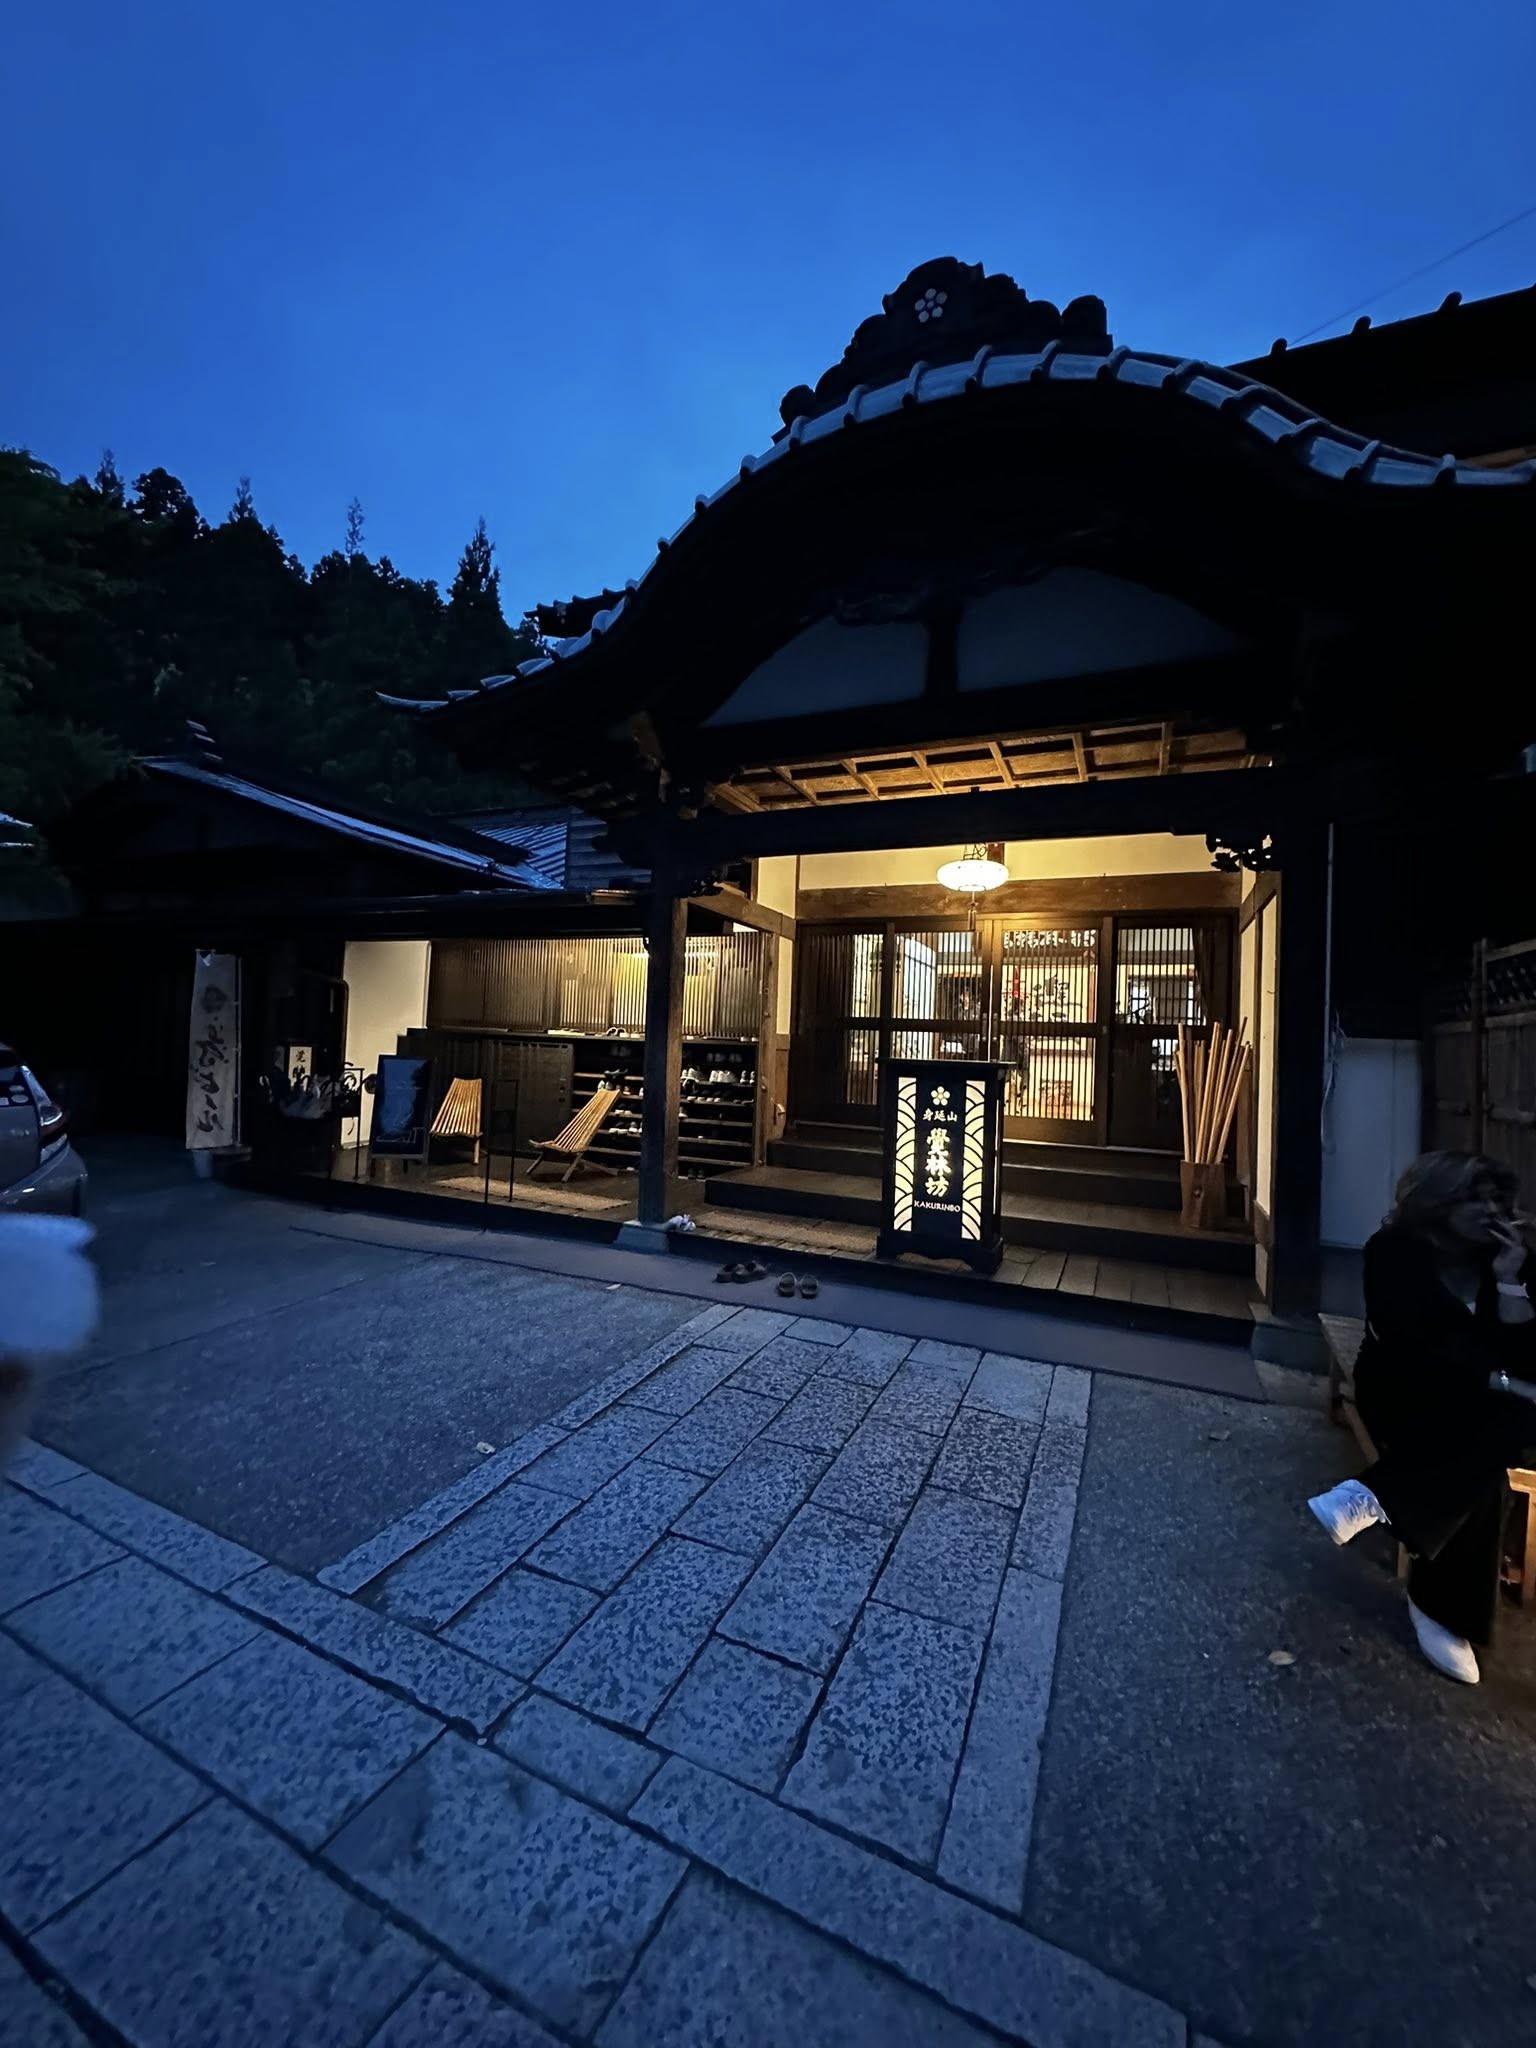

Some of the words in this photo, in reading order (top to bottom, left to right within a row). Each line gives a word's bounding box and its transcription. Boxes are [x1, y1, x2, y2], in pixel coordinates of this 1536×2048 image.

[922, 1107, 958, 1122] 身延山
[913, 1200, 961, 1213] KAKURINBO
